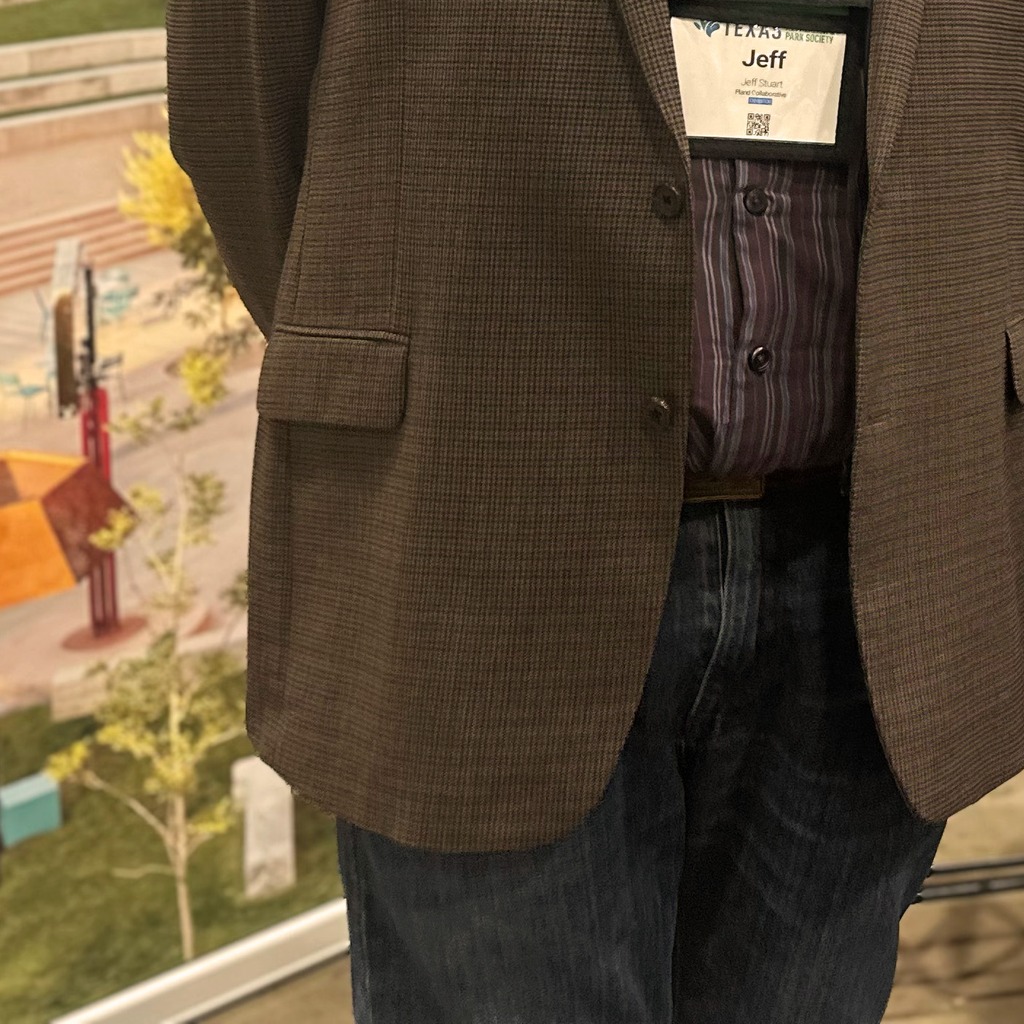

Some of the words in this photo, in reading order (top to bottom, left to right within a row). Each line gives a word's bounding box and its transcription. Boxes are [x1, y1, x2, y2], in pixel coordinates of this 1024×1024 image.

[785, 33, 804, 42] PARK
[805, 34, 834, 44] SOCIETY
[742, 50, 787, 69] Jeff
[741, 78, 758, 87] Jeff
[759, 78, 783, 88] Stuart
[752, 90, 787, 98] Collaborative
